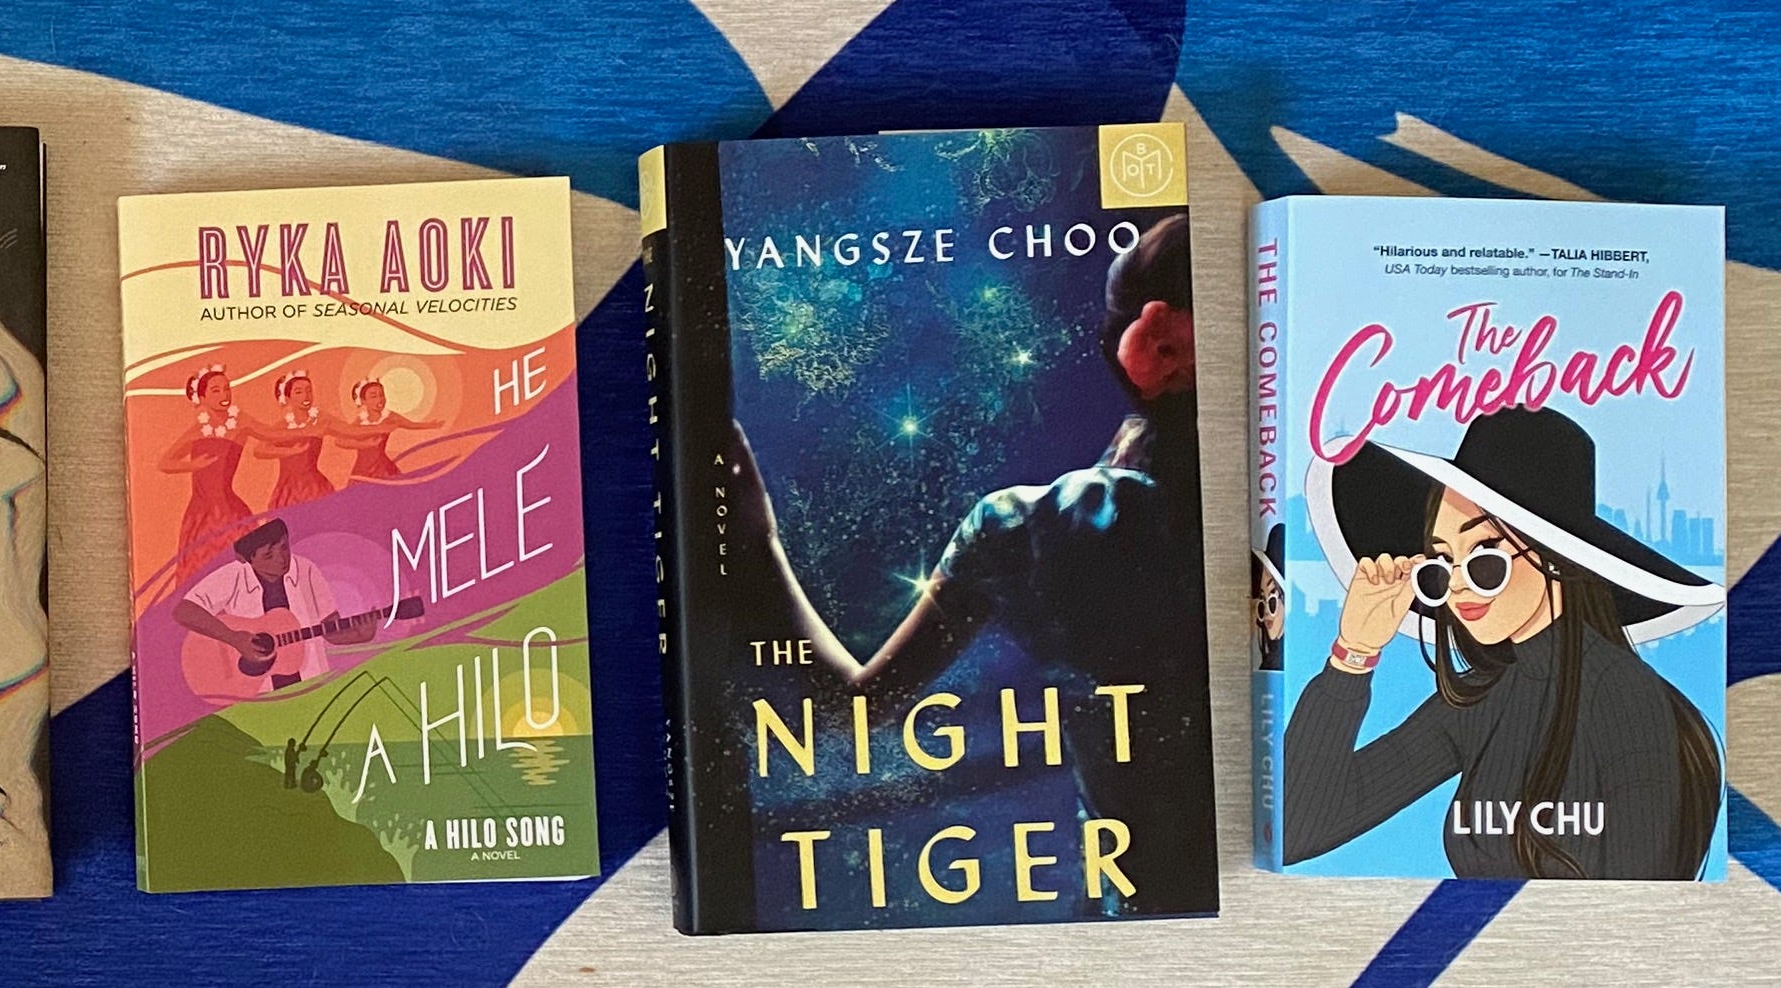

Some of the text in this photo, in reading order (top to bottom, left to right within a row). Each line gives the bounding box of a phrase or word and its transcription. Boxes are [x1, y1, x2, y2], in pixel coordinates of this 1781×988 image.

[198, 216, 515, 300] RYKA AOKI
[724, 221, 1142, 271] YANGSZE CHOO
[1384, 263, 1639, 280] USA Today bestselling author, for The Stand-In
[1441, 246, 1466, 258] and
[1591, 250, 1650, 264] HIBBERT,
[200, 297, 518, 322] AUTHOR OF SEASONAL VELOCITIES
[1447, 302, 1522, 365] The
[493, 346, 548, 415] HE
[1258, 237, 1278, 518] THE COMEBACK
[1309, 290, 1694, 465] Comeback
[384, 444, 553, 630] MELE
[714, 454, 728, 576] A NOVEL
[749, 639, 814, 667] THE
[351, 723, 397, 804] A
[420, 626, 561, 785] HILO
[751, 684, 1146, 778] NIGHT
[1261, 693, 1274, 809] LILY CHU
[424, 815, 565, 851] A HILO SONG
[1452, 800, 1605, 836] LILY CHU
[470, 850, 521, 861] A NOVEL
[780, 818, 1137, 910] TIGER
